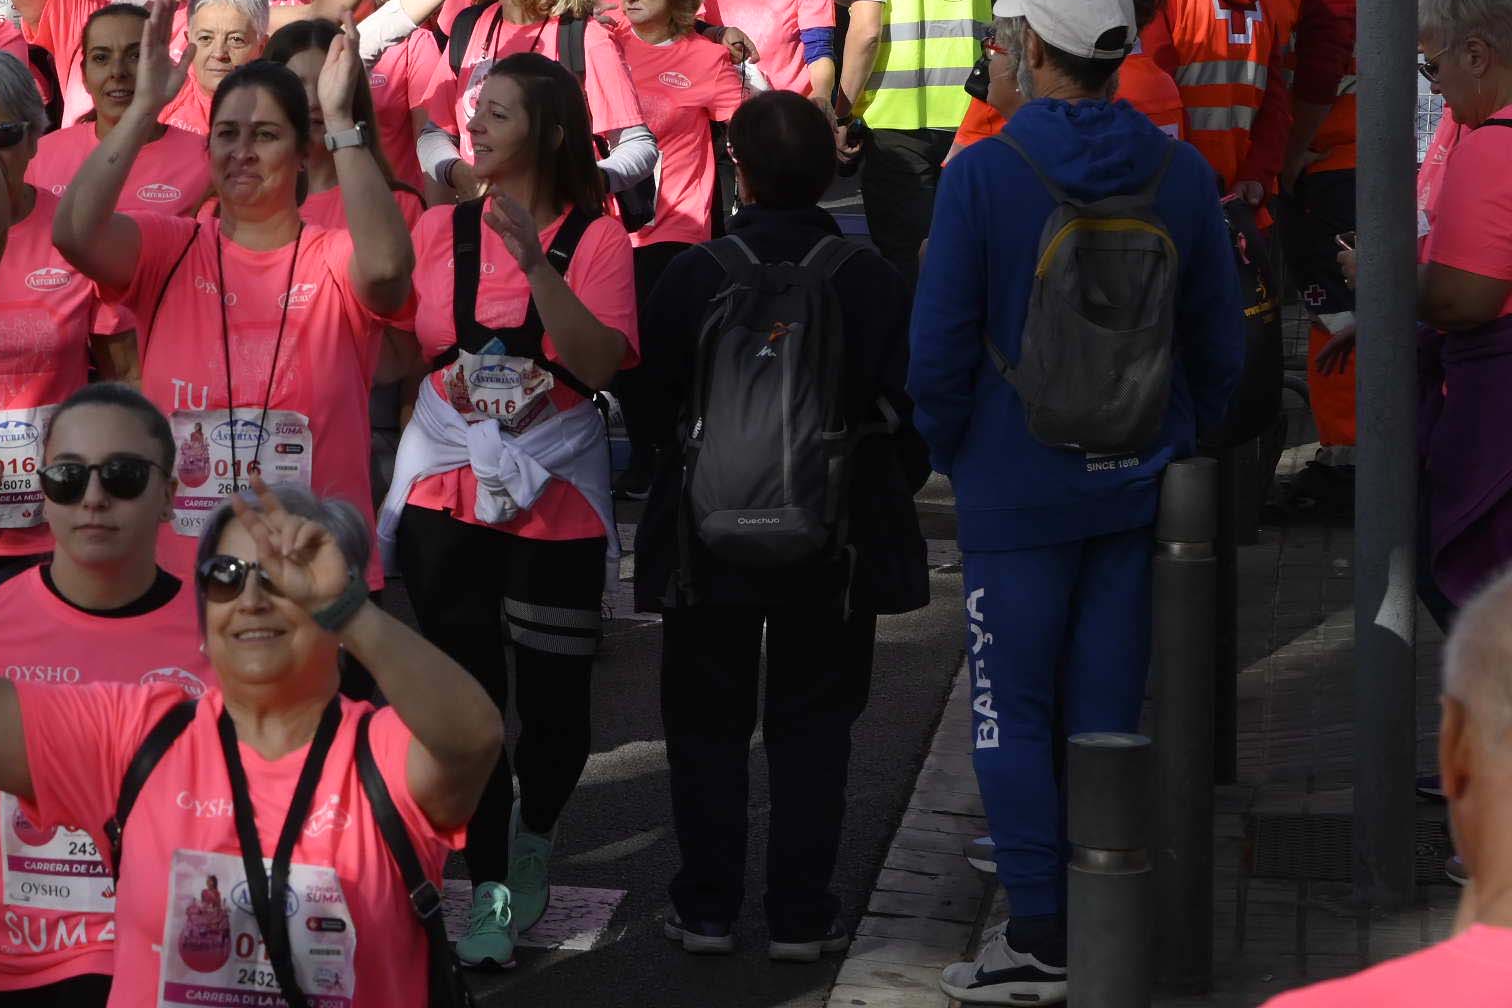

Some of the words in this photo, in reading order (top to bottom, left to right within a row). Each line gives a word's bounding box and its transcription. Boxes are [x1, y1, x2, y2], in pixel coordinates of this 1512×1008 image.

[170, 378, 208, 411] TU
[1086, 460, 1115, 472] SINCE
[737, 516, 780, 525] Quechua
[5, 665, 80, 684] OYSHO
[23, 860, 70, 873] CARRERA
[72, 862, 89, 873] DE
[90, 863, 104, 874] LA
[20, 881, 71, 900] OYSHO
[186, 988, 239, 1005] CARRERA
